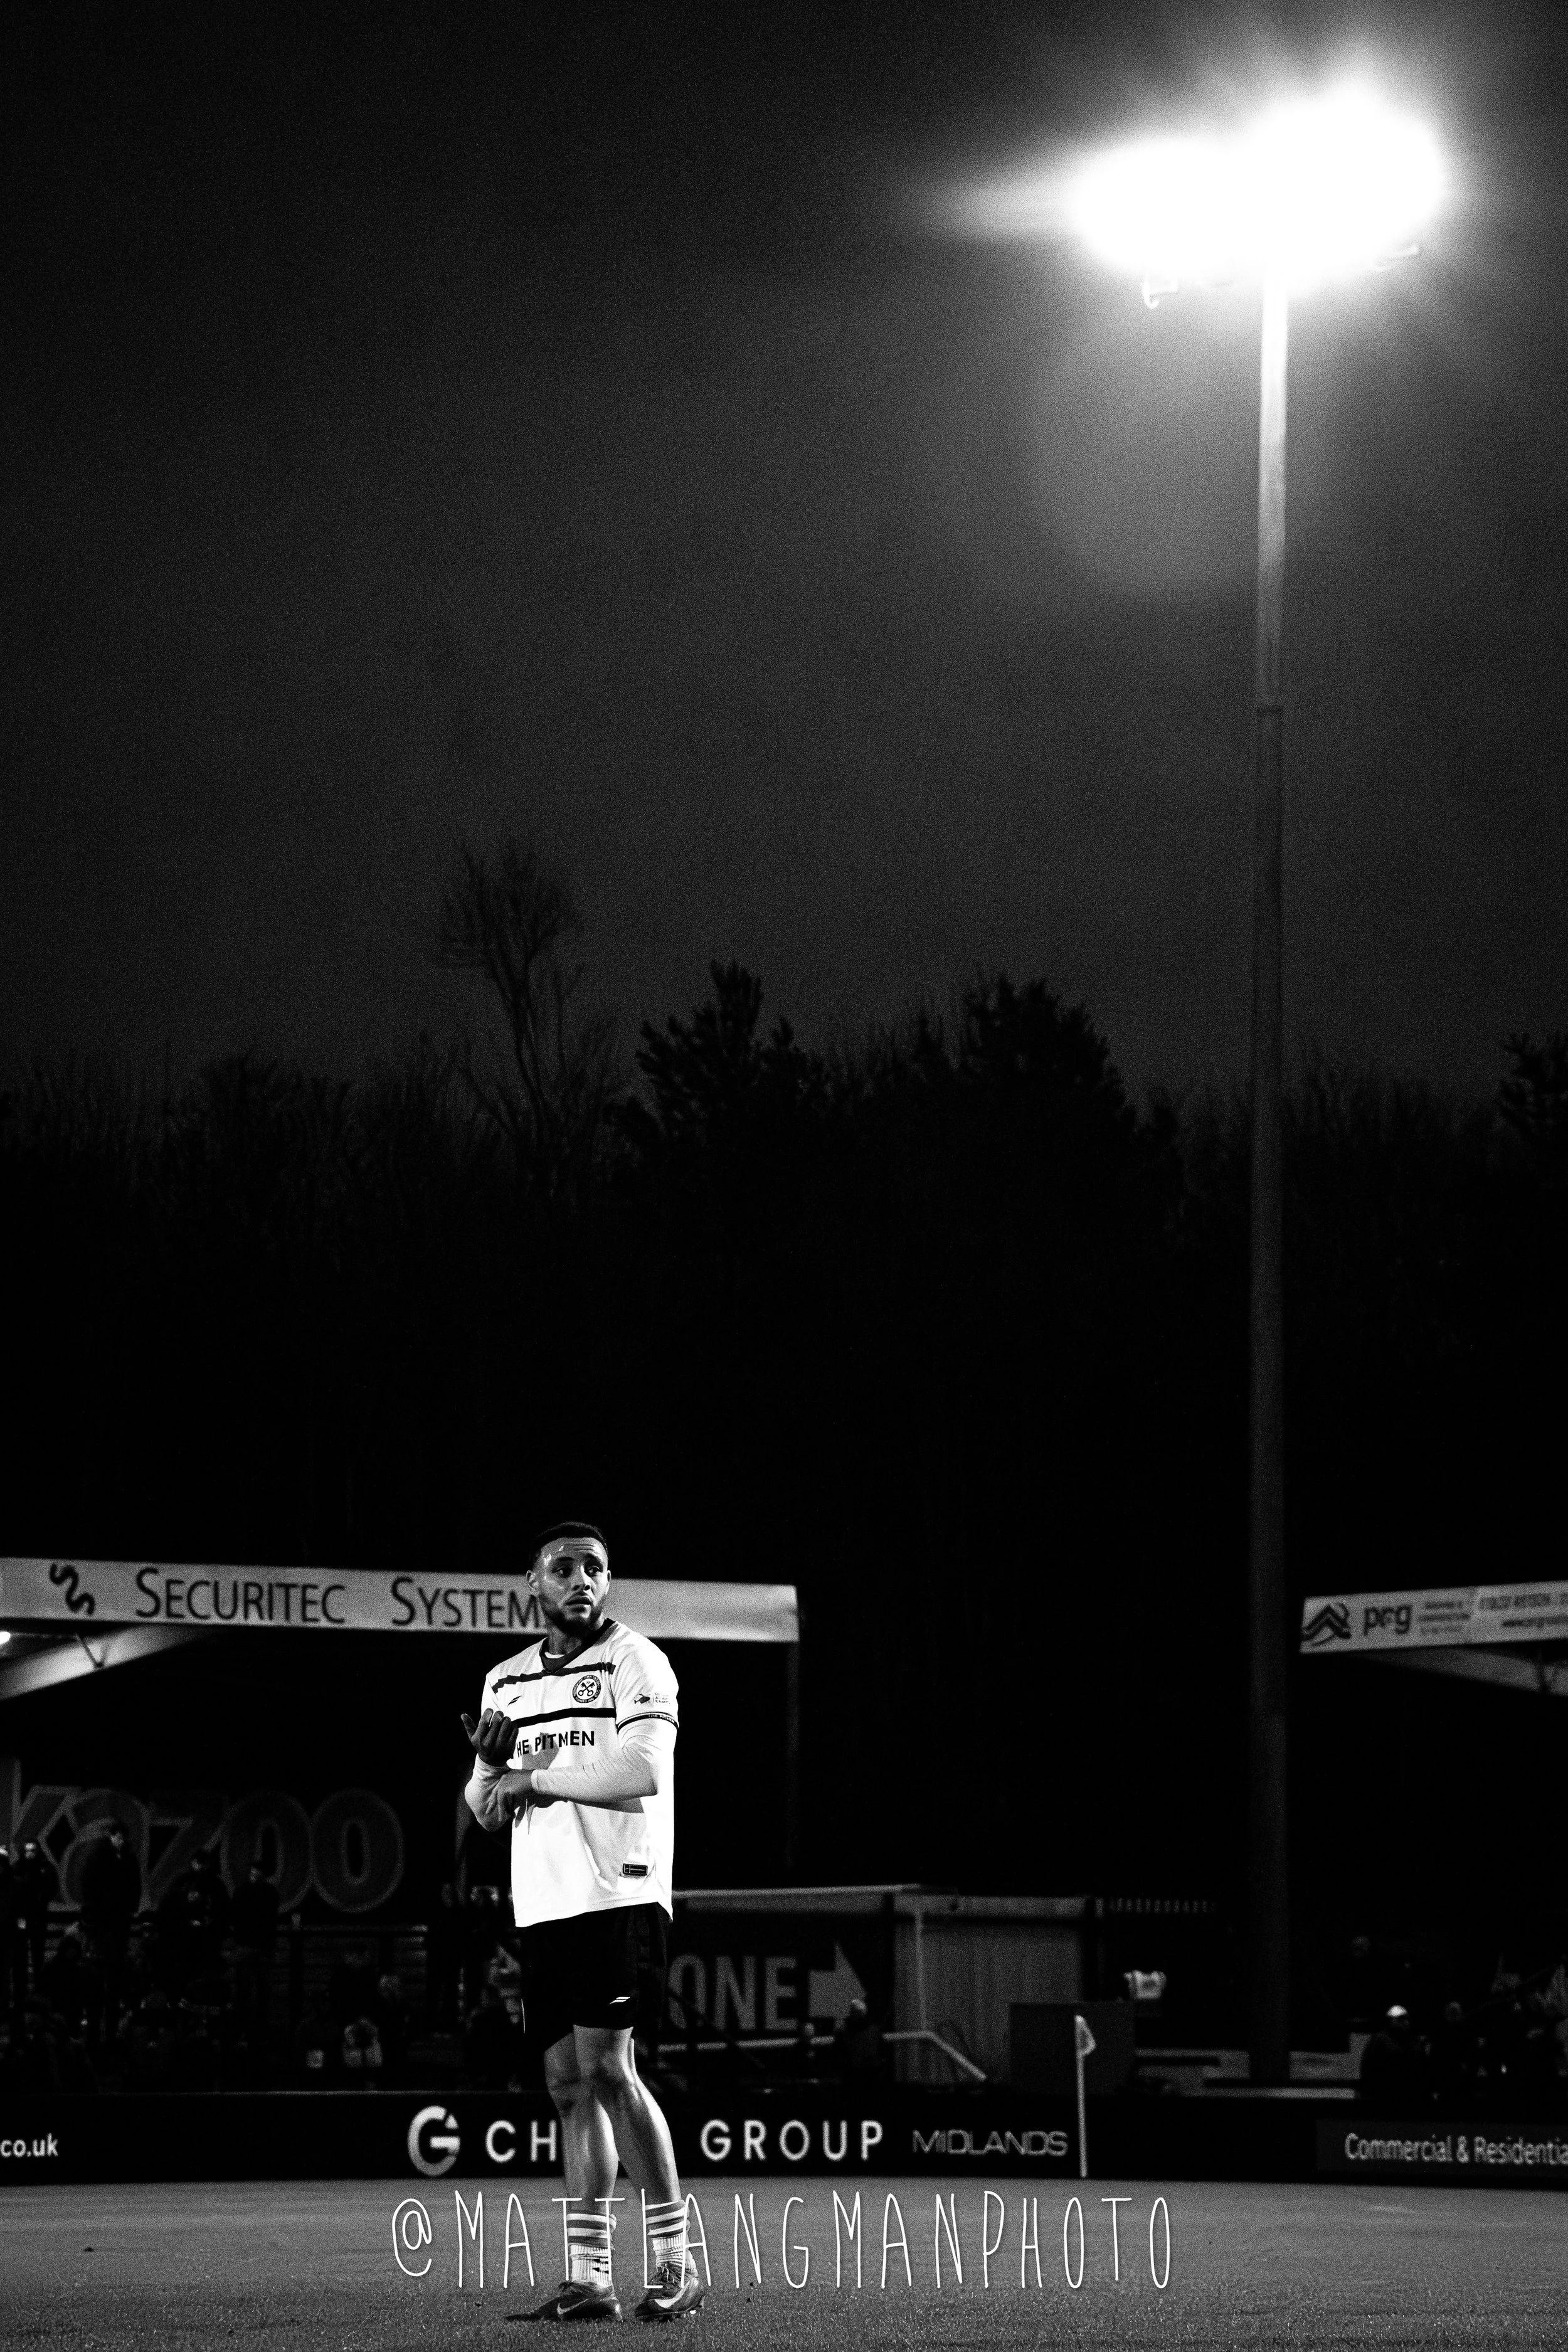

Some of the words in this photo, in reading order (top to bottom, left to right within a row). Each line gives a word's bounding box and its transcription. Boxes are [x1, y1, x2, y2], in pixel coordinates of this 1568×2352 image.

[135, 1567, 346, 1624] SECURITEC
[391, 1576, 541, 1628] SYSTEM
[1364, 1604, 1412, 1635] prg
[517, 1739, 529, 1757] HE
[535, 1730, 595, 1752] PITMEN
[485, 2119, 558, 2163] CH
[700, 2119, 882, 2162] GROUP
[912, 2129, 1068, 2157] MIDLANDS
[1345, 2132, 1453, 2163] Commercial
[1456, 2135, 1470, 2164] &
